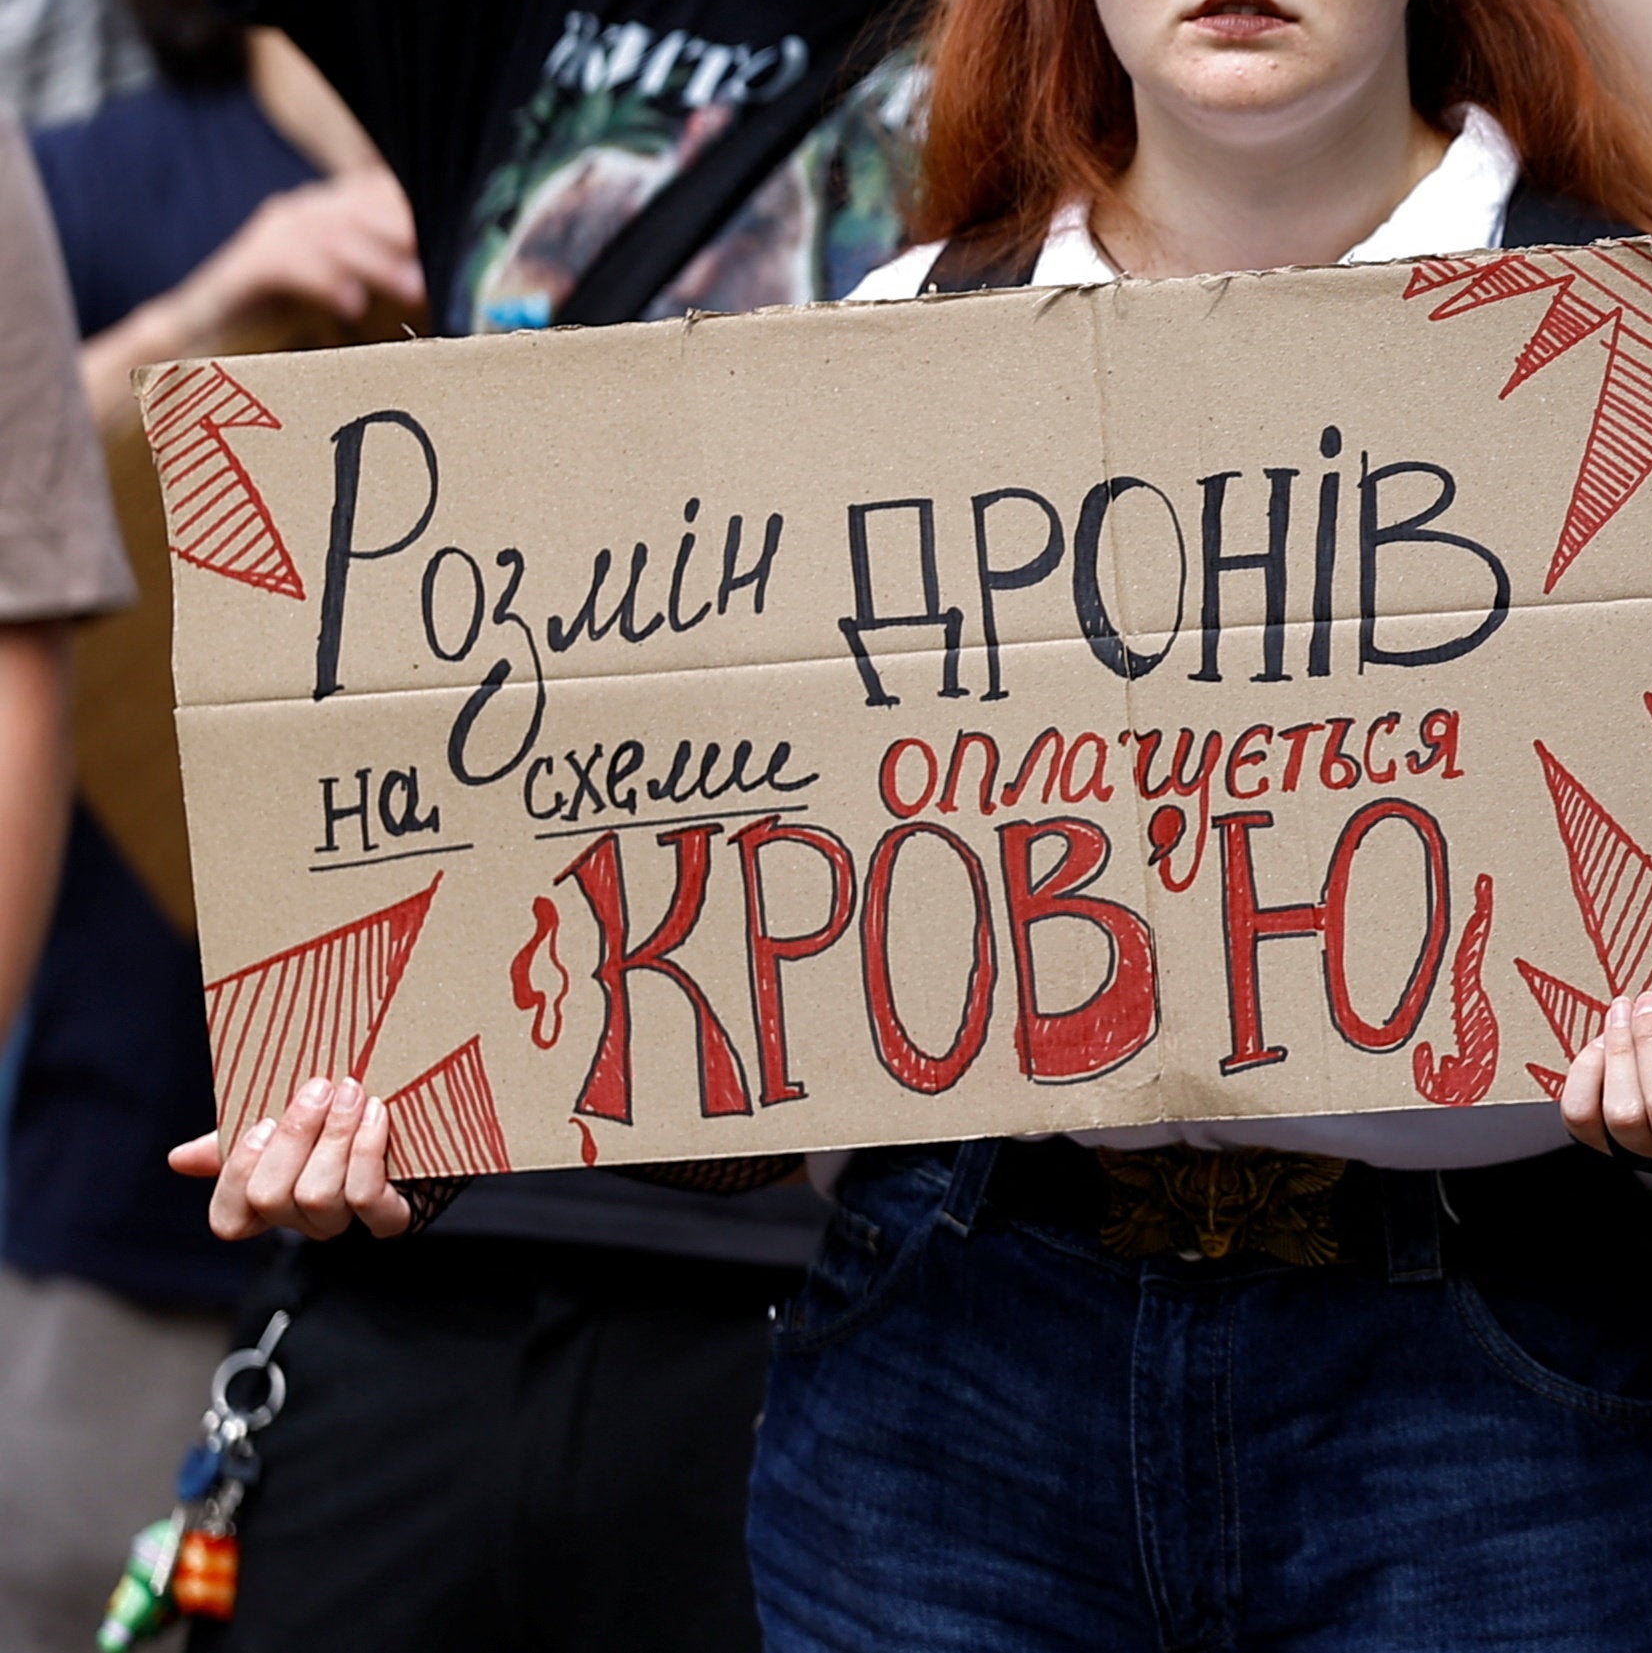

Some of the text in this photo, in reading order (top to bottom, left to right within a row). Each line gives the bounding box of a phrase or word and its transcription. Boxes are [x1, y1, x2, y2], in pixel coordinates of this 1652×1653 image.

[311, 408, 786, 786] Розмін
[522, 739, 819, 823] схеми
[879, 707, 1467, 893] оплачується
